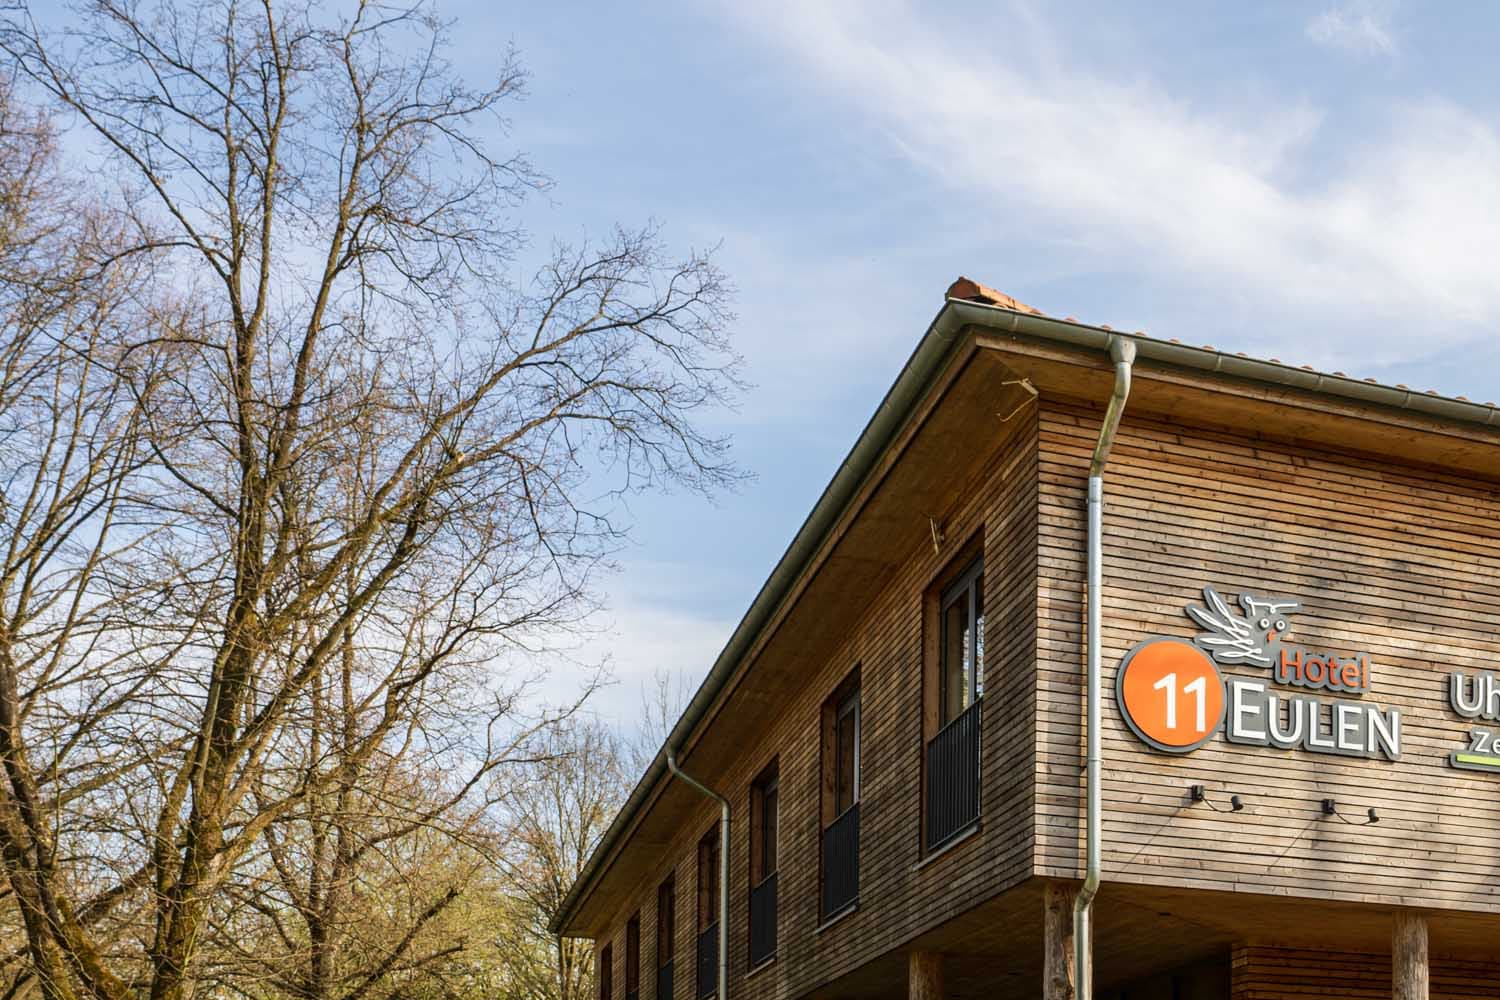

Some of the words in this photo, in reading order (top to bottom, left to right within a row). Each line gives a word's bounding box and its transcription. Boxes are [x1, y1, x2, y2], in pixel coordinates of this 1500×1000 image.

[1280, 648, 1369, 689] Hotel
[1153, 672, 1207, 733] 11
[1232, 680, 1399, 755] EULEN
